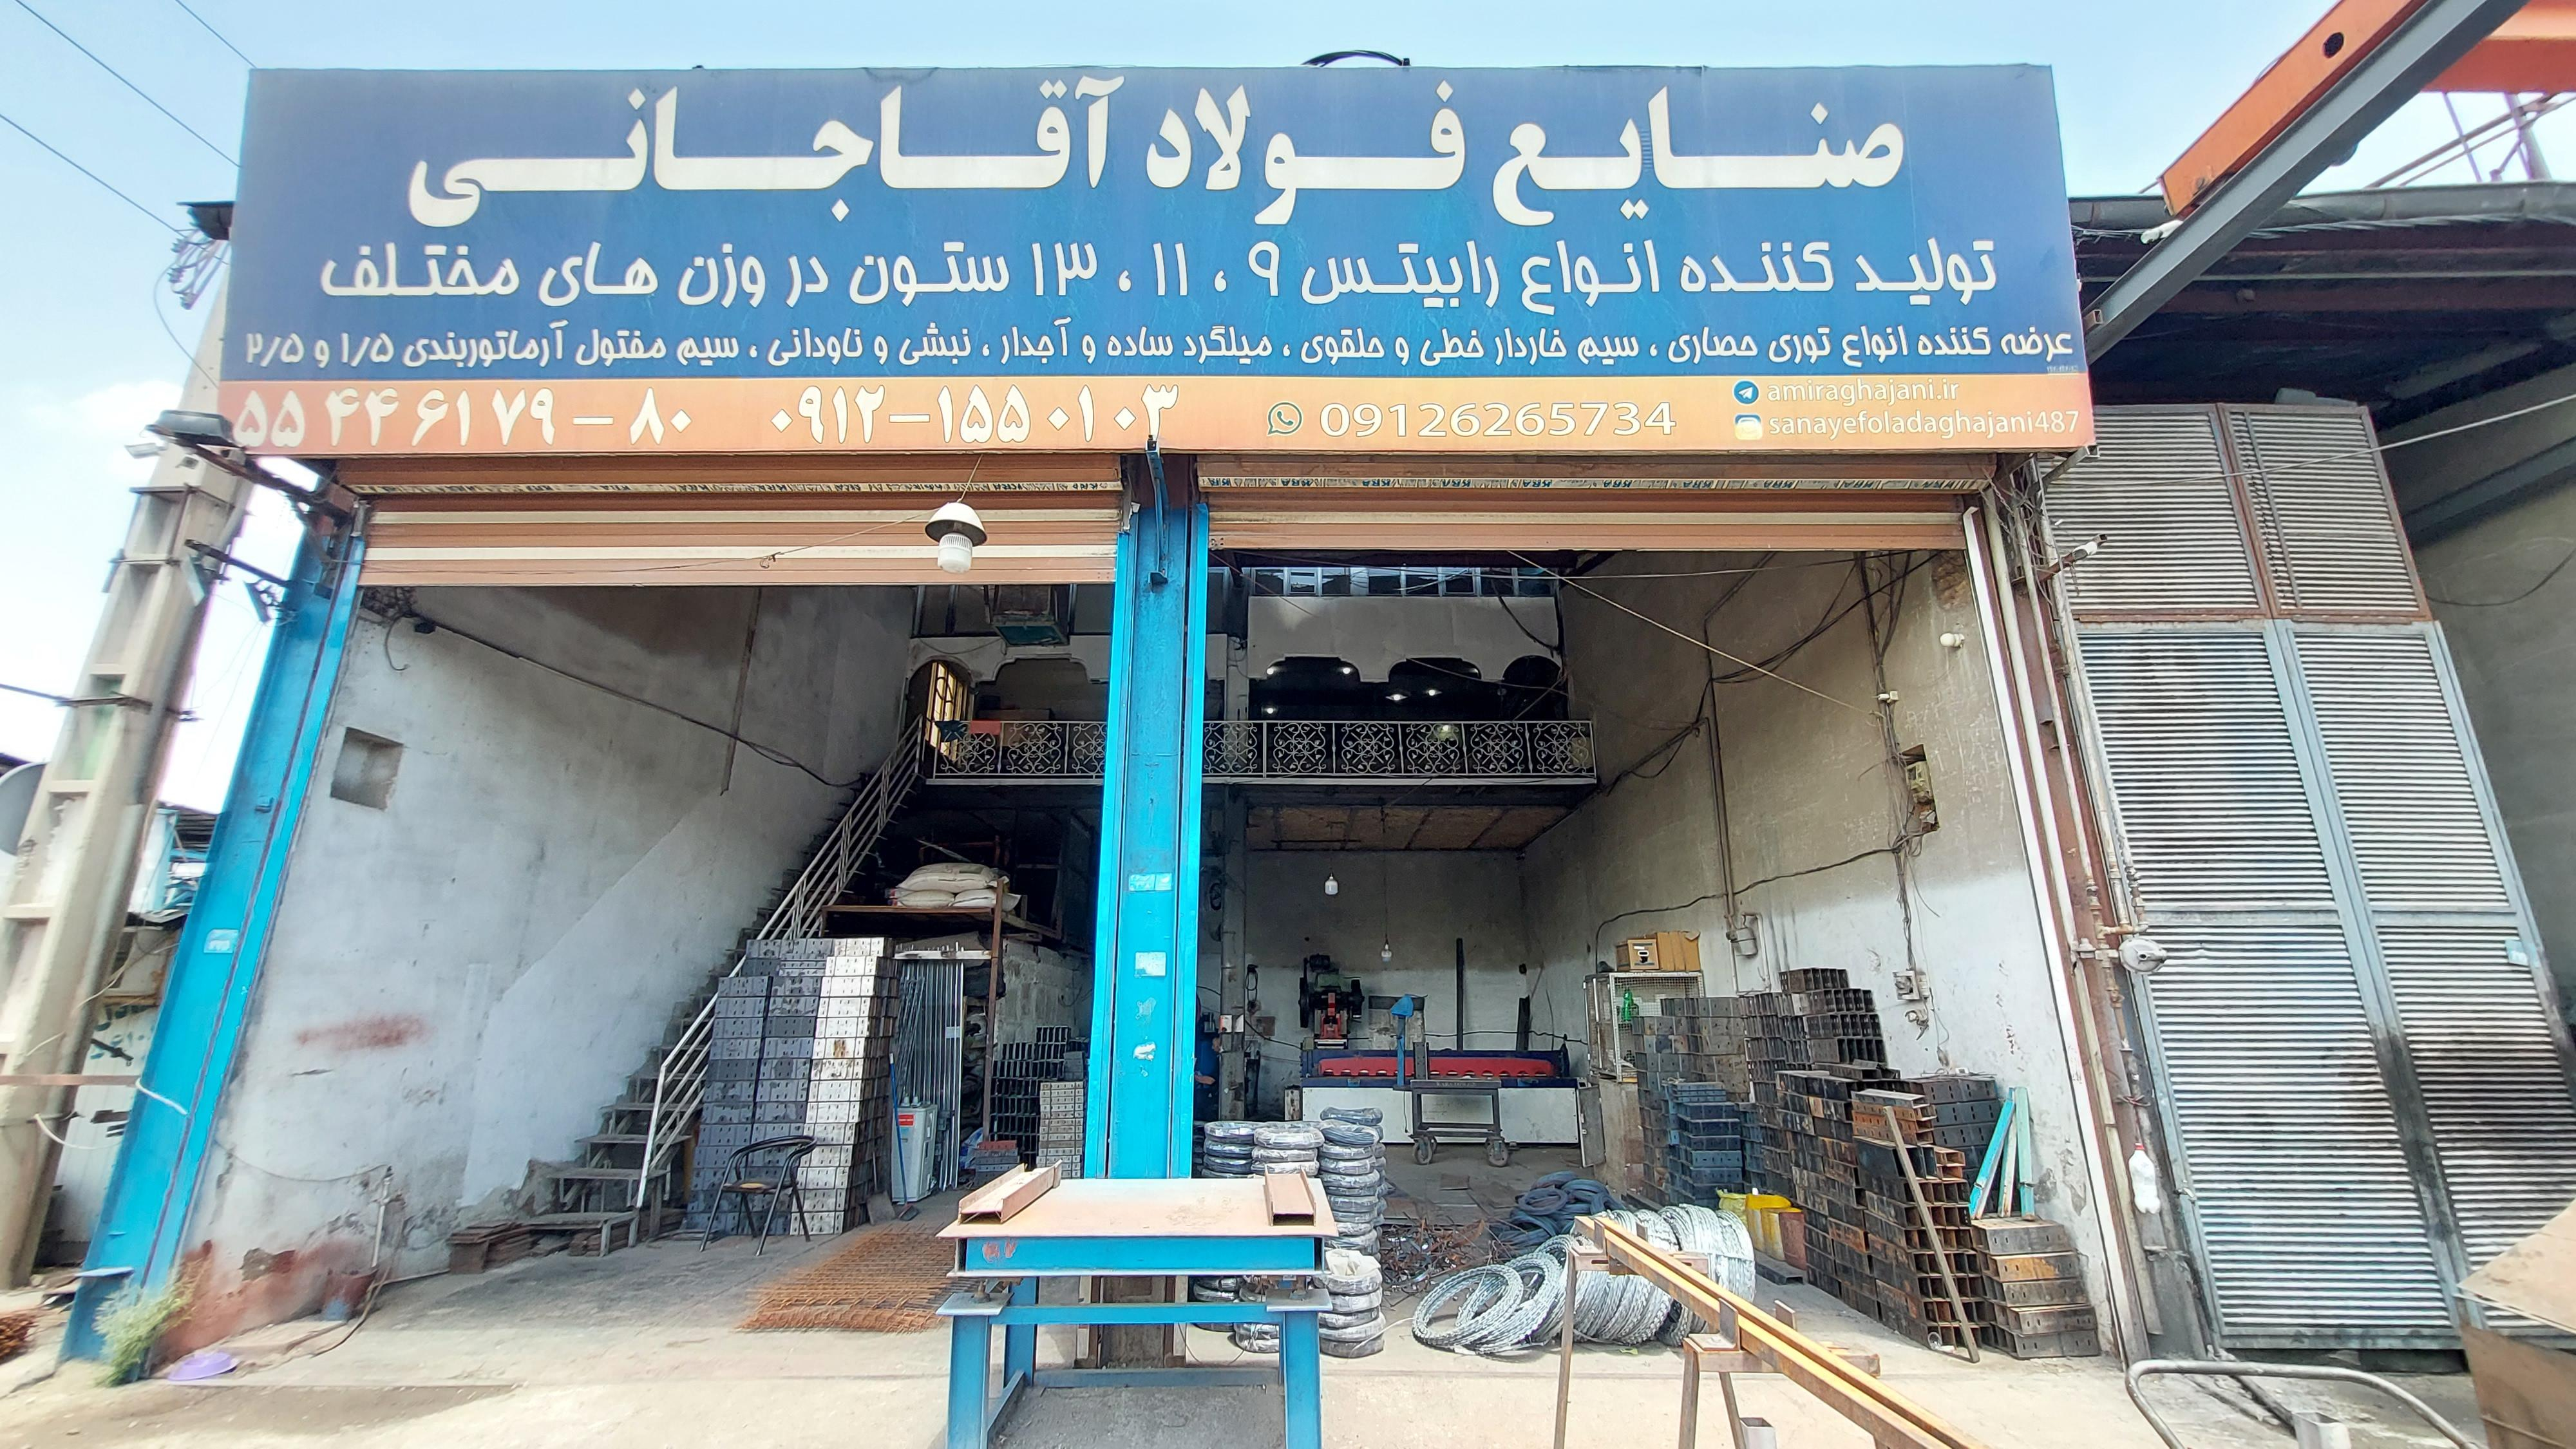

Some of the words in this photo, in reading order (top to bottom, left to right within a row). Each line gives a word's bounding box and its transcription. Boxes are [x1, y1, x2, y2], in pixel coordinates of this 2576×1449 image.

[409, 75, 1124, 227] آقاجانی
[1146, 80, 1466, 225] فولاد
[1493, 86, 1904, 226] صنایع
[321, 242, 519, 296] مختلف
[538, 242, 658, 307] های
[678, 243, 766, 308] وزن
[786, 256, 829, 308] در
[849, 242, 1010, 307] ستون
[1032, 242, 1097, 296] ۱۳
[1153, 242, 1188, 296] ۱۱
[1248, 241, 1280, 296] ۹
[1302, 240, 1499, 308] رابیتس
[1521, 240, 1660, 316] انواع
[1680, 242, 1834, 292] کننده
[1855, 237, 1996, 305] تولید
[314, 339, 329, 368] و
[402, 319, 569, 368] آرماتوربندی
[575, 328, 667, 366] مفتول
[676, 337, 739, 366] سیم
[767, 327, 863, 366] ناودانی
[874, 336, 888, 365] و
[898, 322, 971, 365] نبشی
[1001, 317, 1072, 365] آجدار
[1082, 337, 1096, 364] و
[1107, 327, 1173, 356] ساده
[1184, 325, 1273, 365] میلگرد
[1301, 328, 1385, 365] حلقوی
[1395, 337, 1410, 366] و
[1420, 328, 1484, 366] خطی
[1495, 328, 1567, 365] خاردار
[1577, 336, 1639, 365] سیم
[1668, 327, 1758, 364] حصاری
[1768, 327, 1831, 364] توری
[1842, 325, 1908, 367] انواع
[1918, 327, 1991, 355] کننده
[2000, 327, 2073, 362] عرضه
[1768, 378, 1958, 406] amiraghajani.ir
[1321, 401, 1676, 437] 09126265734
[1770, 410, 2079, 439] sanayefoladaghajani487
